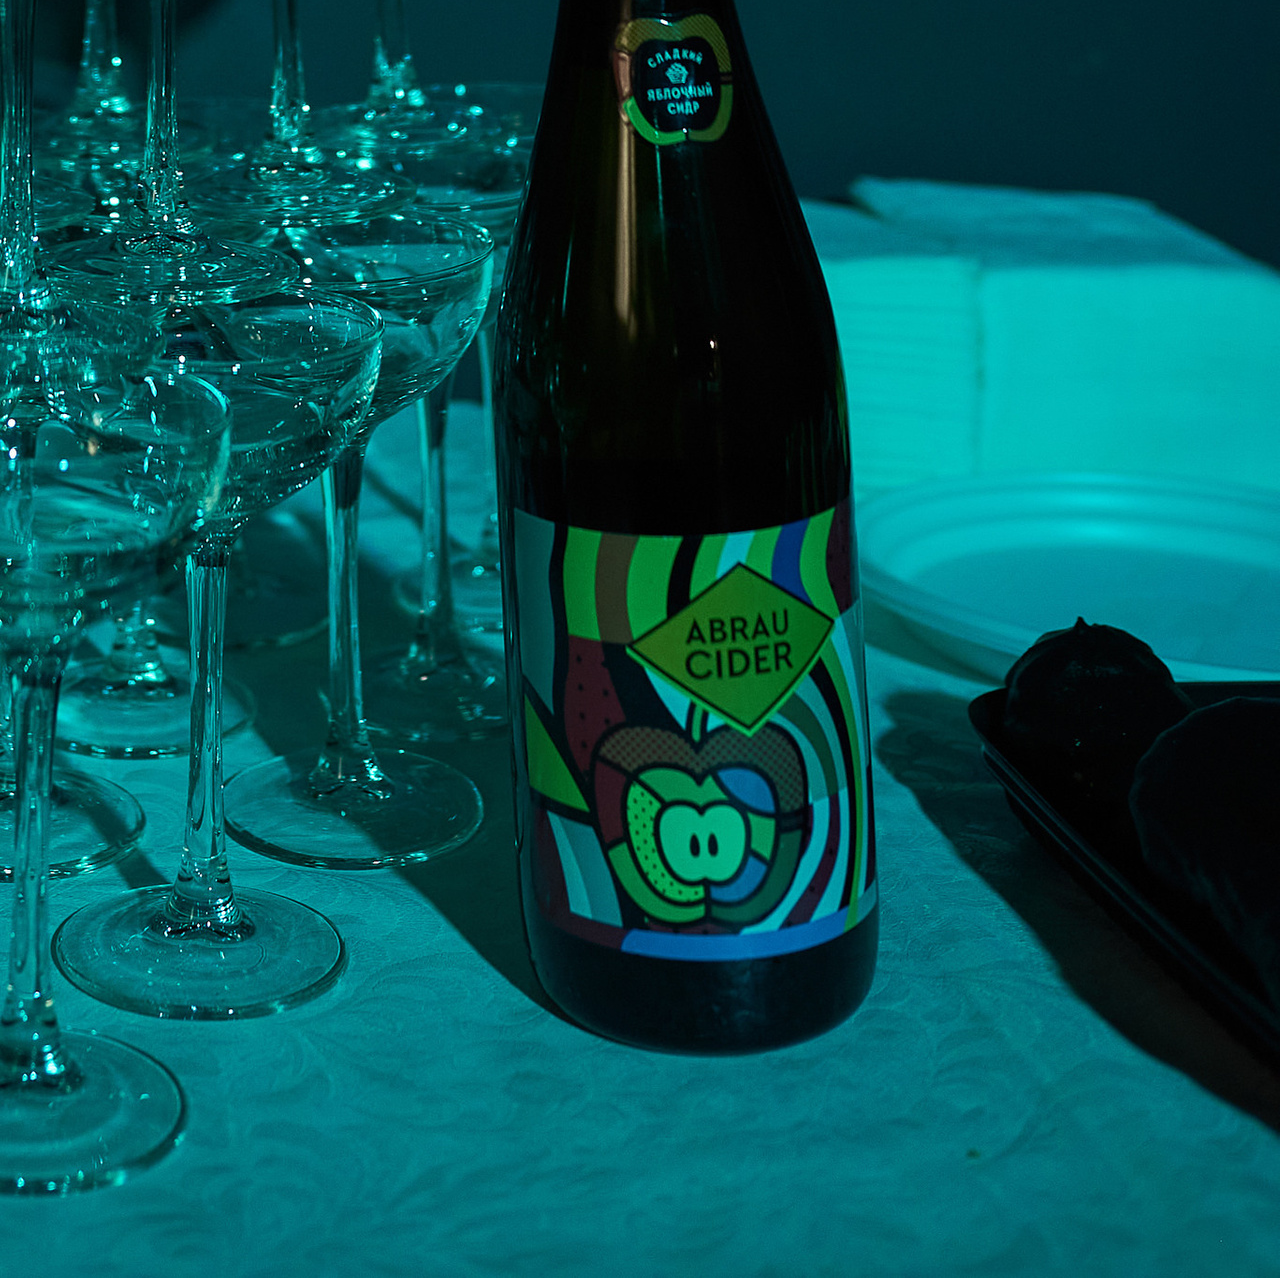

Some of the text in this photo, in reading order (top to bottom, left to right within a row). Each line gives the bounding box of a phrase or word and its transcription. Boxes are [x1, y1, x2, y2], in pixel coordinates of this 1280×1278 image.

[647, 48, 703, 68] СЛАДКИЙ
[647, 82, 713, 102] ЯБЛОЧНЫЙ
[666, 100, 700, 115] СИДР
[685, 607, 789, 645] ABRAU
[685, 641, 793, 680] CIDER
